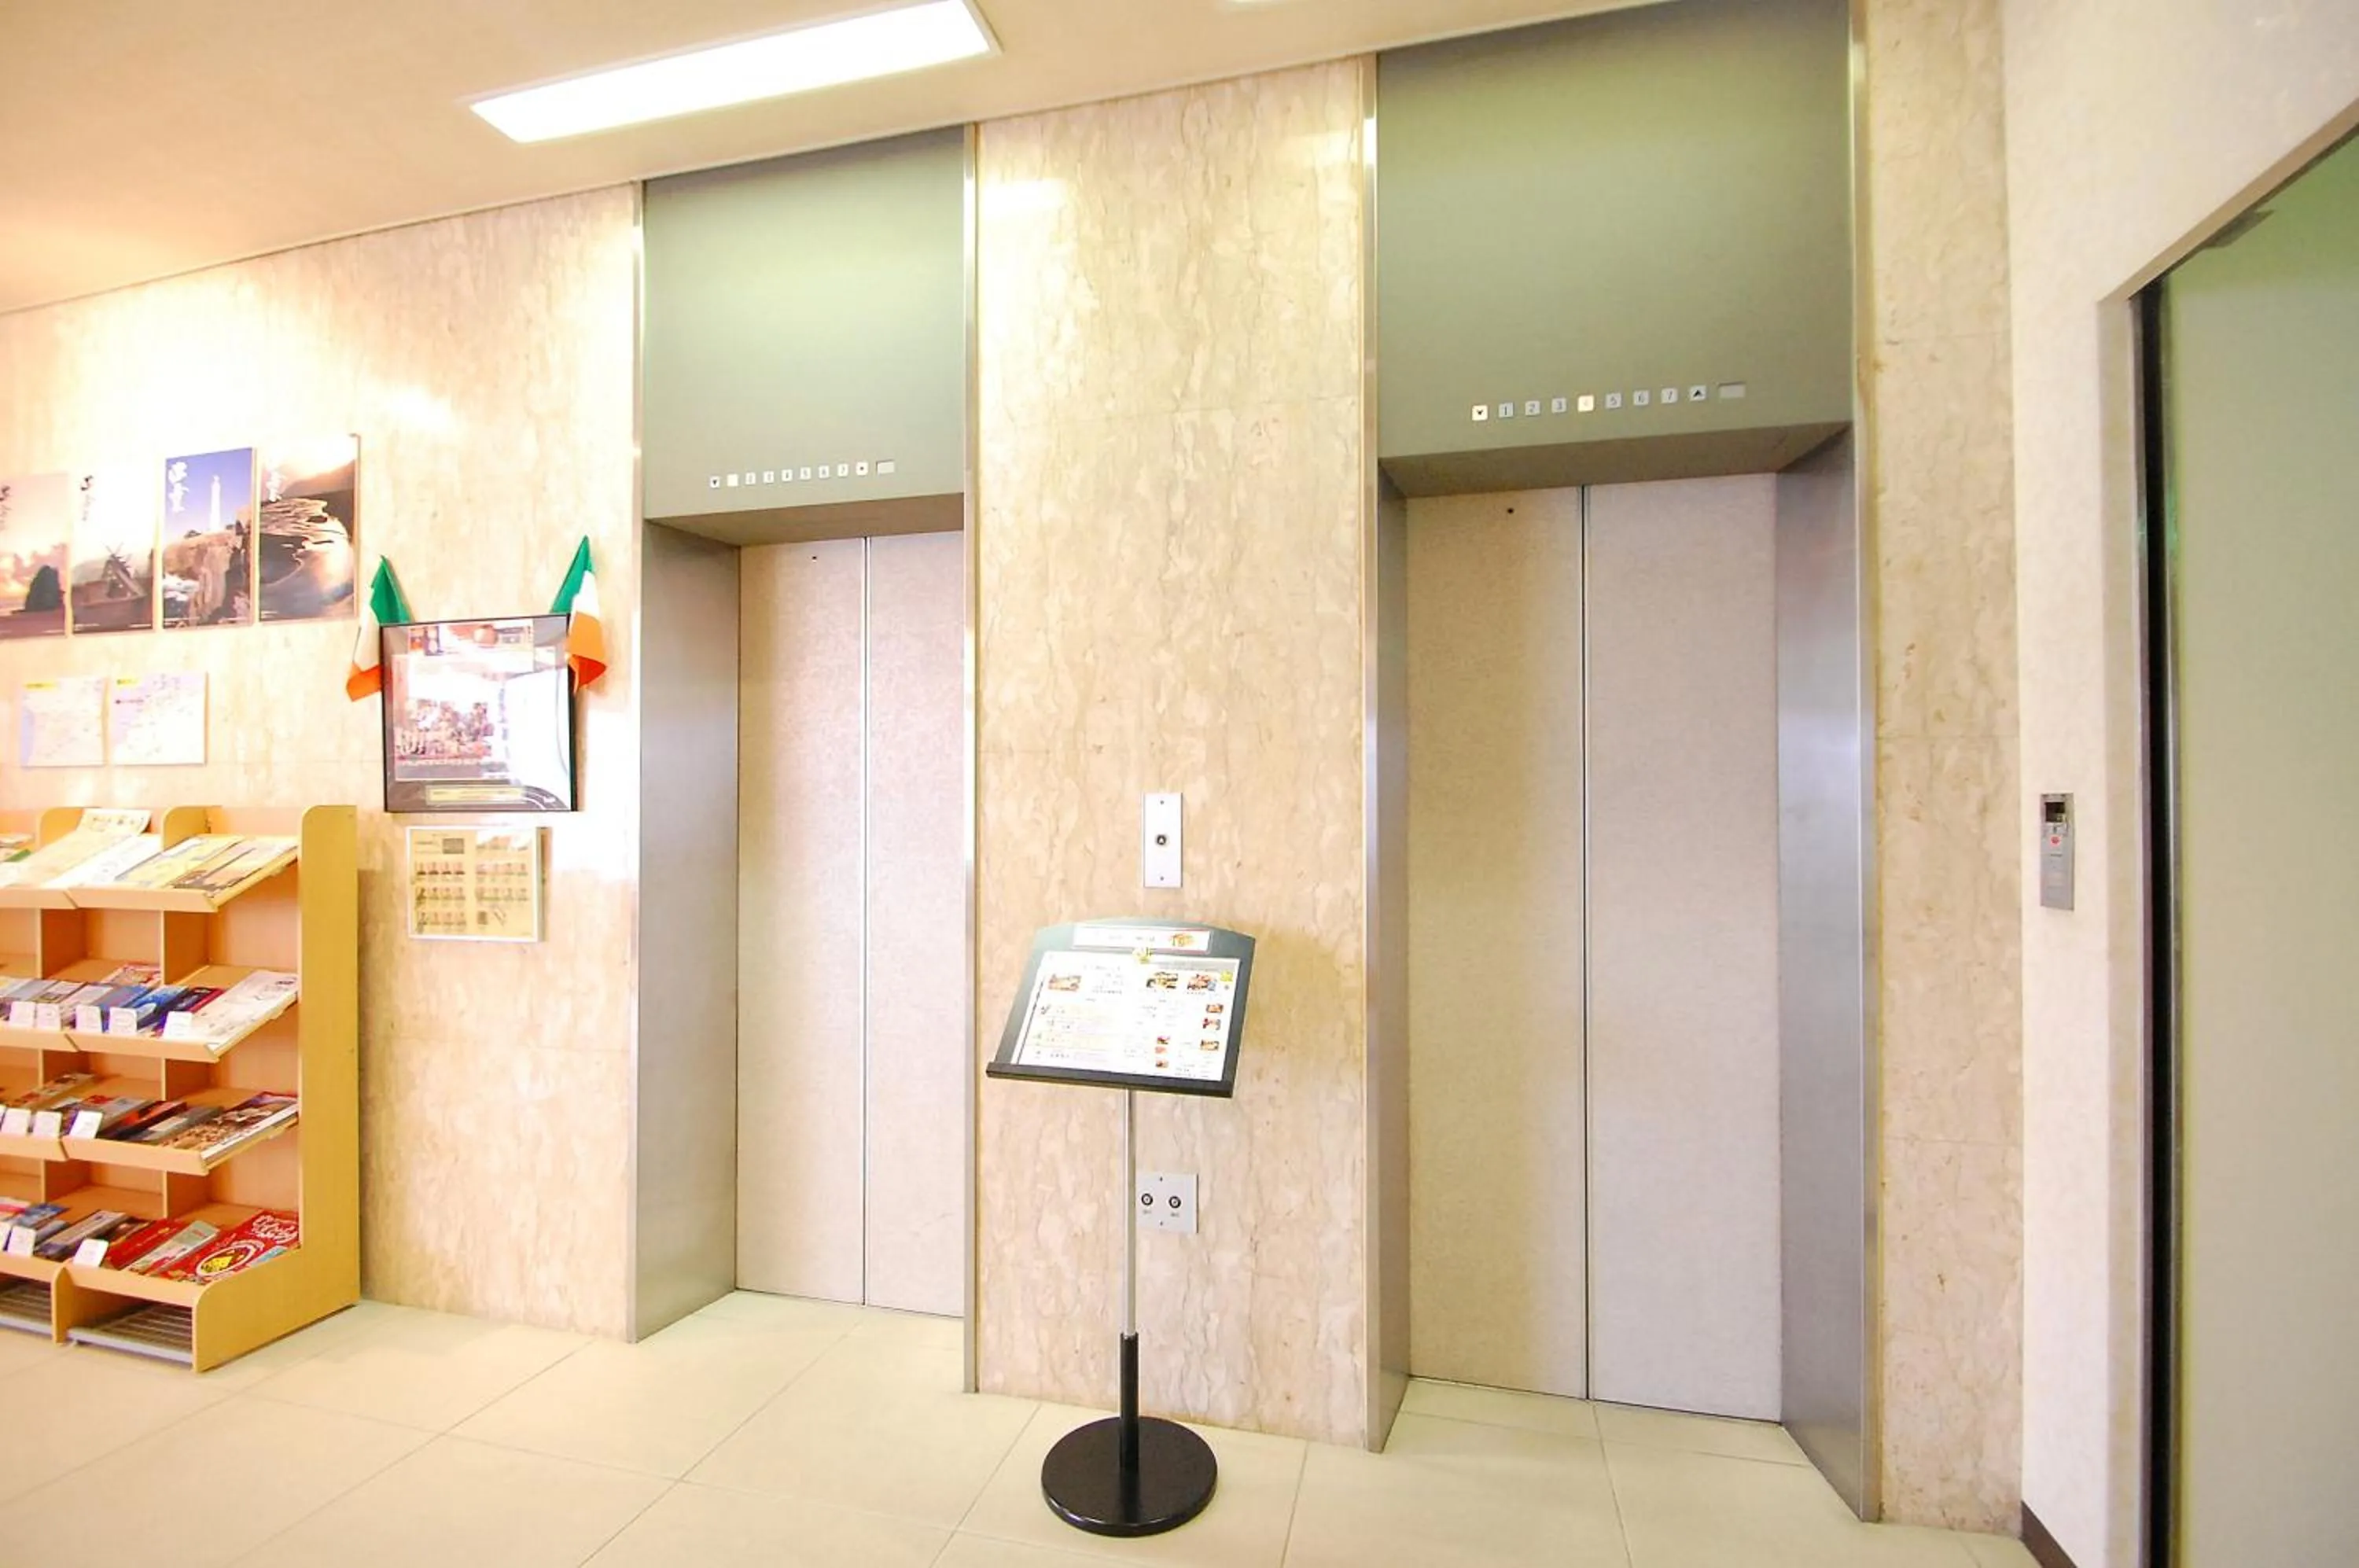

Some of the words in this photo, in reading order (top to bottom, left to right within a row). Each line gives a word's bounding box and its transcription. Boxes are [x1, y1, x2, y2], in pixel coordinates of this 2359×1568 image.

[1528, 403, 1536, 414] 2
[1555, 400, 1563, 410] 3
[1610, 396, 1617, 406] 5
